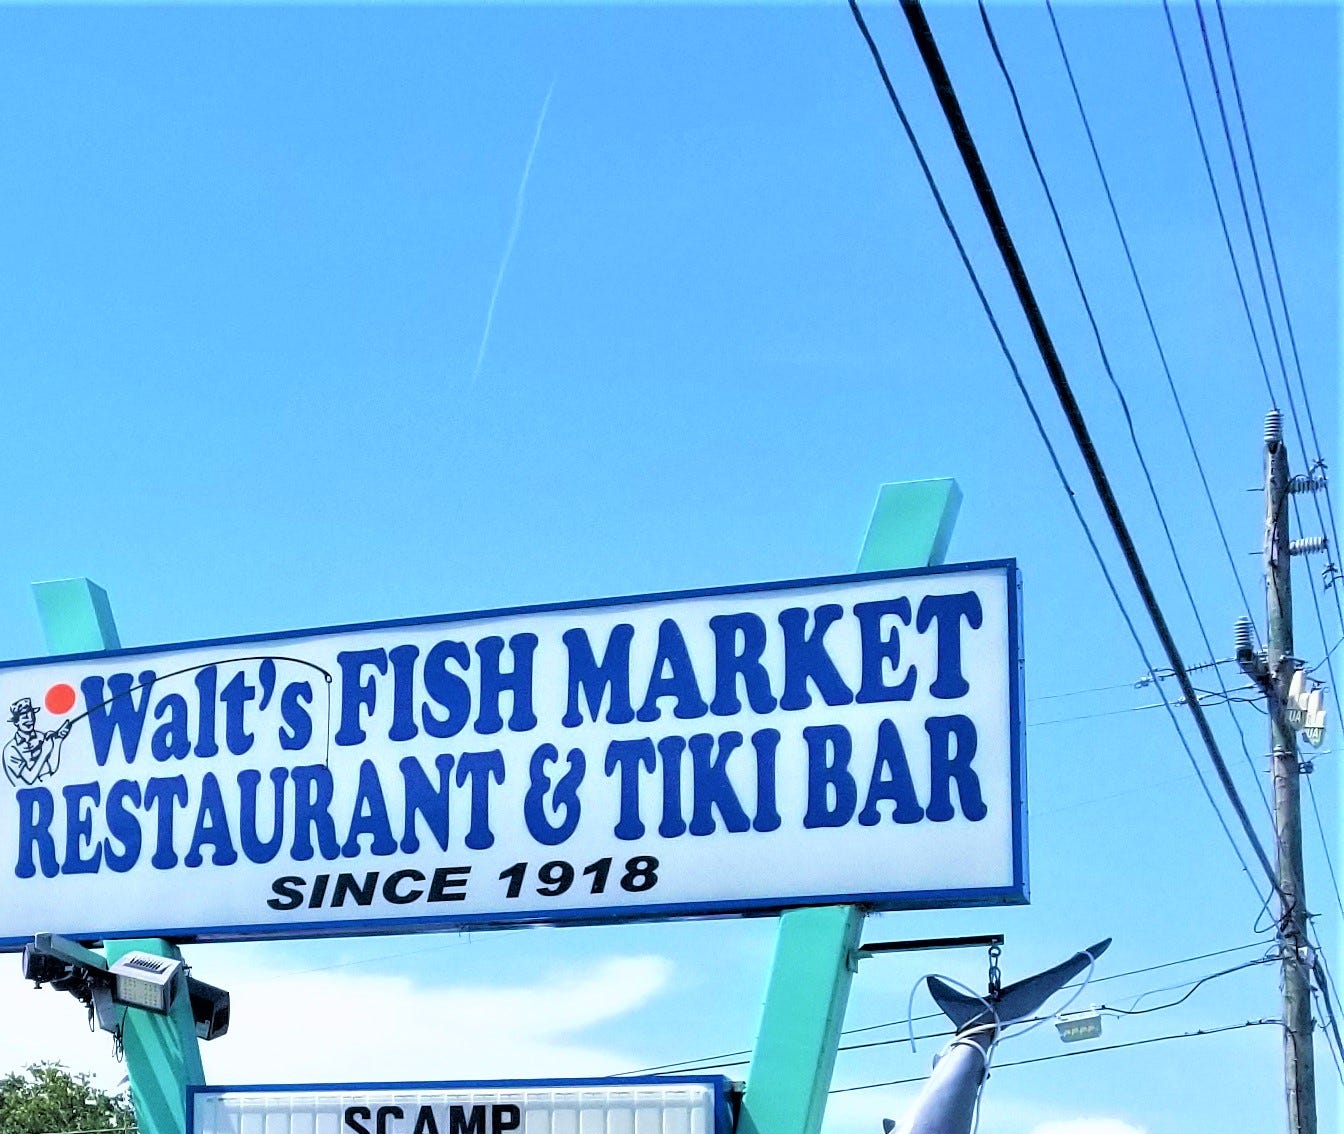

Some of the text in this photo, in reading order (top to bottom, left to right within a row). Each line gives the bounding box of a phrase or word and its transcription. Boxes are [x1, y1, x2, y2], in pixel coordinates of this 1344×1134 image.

[80, 590, 983, 766] Walt's FISH MARKET
[14, 714, 988, 878] RESTAURANT & TIKI BAR
[266, 855, 660, 910] SINCE 1918
